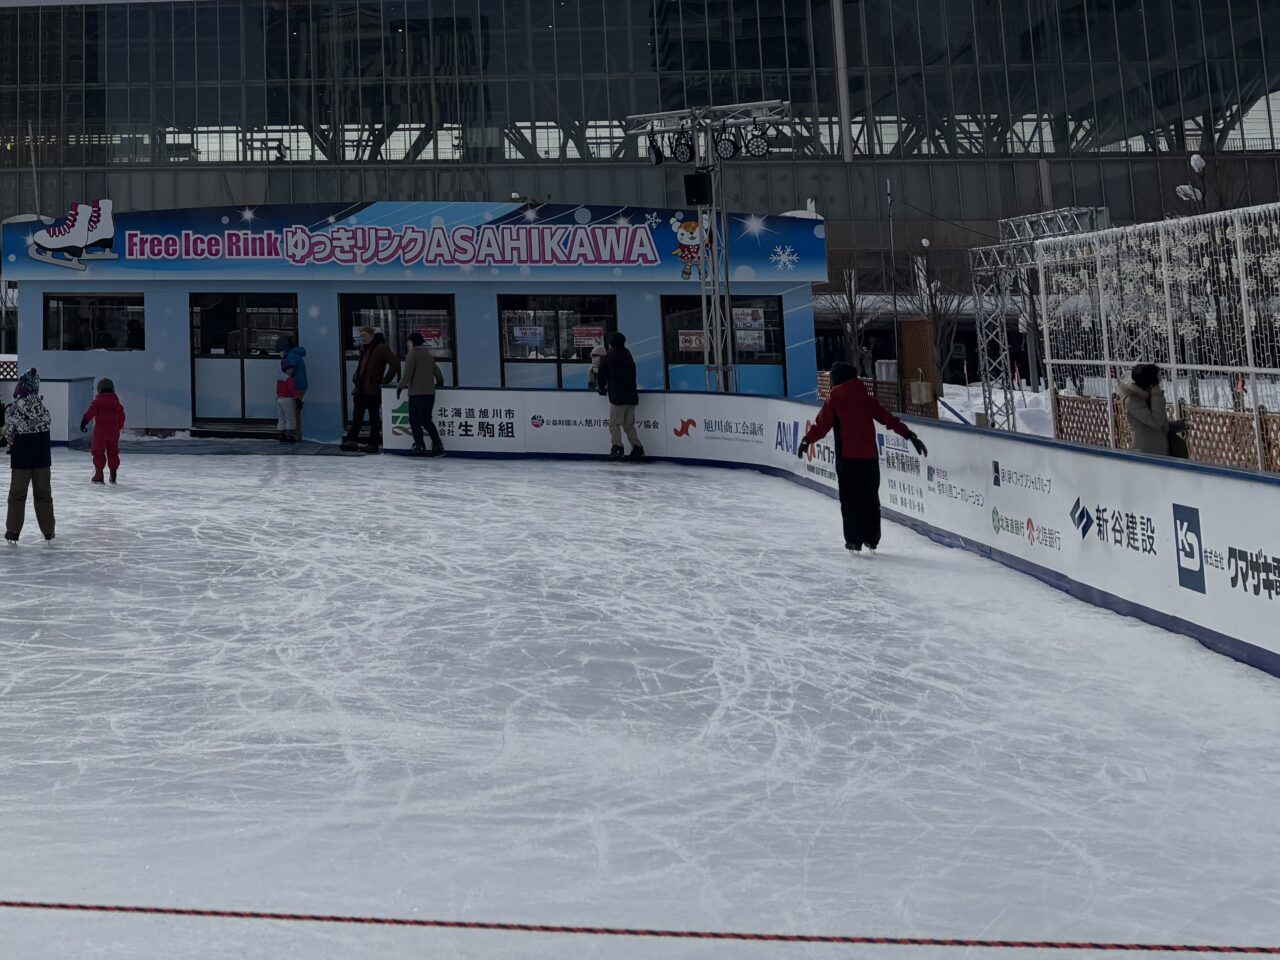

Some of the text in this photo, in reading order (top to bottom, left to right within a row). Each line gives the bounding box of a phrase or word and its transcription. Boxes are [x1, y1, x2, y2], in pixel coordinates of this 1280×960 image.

[126, 230, 177, 259] Free
[182, 230, 221, 259] Ice
[225, 230, 282, 259] Rink
[437, 407, 516, 419] 北海道旭川市
[458, 421, 516, 438] 生駒組
[704, 418, 764, 437] 旭川商工会議所
[1095, 504, 1158, 556] 新谷建設
[1204, 548, 1225, 570] 株式会社
